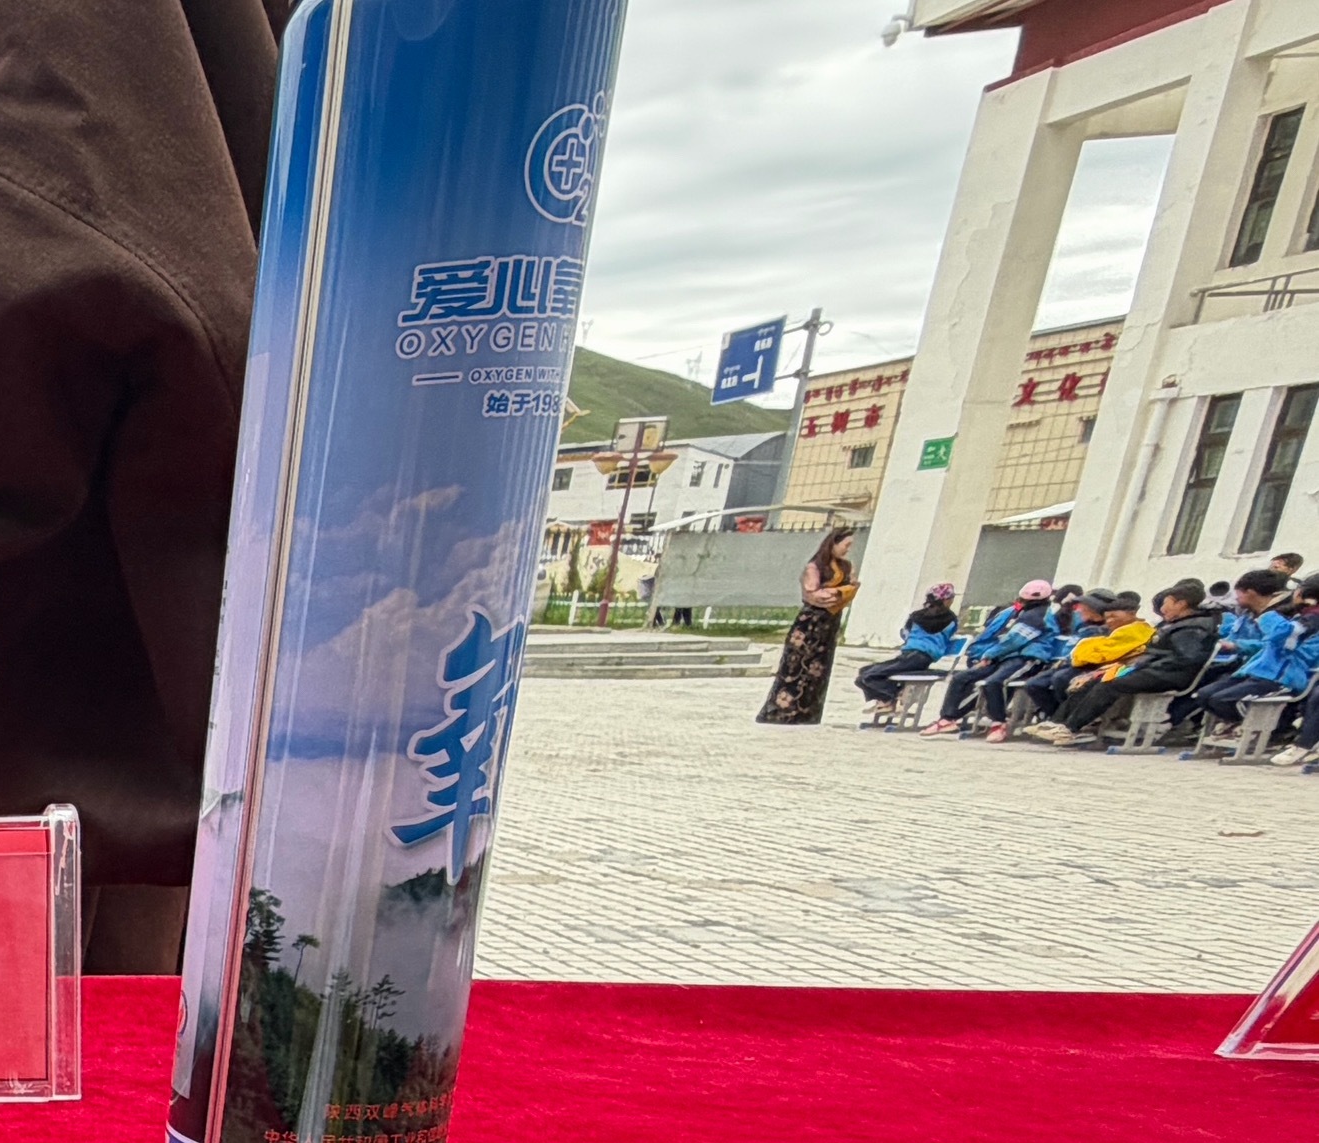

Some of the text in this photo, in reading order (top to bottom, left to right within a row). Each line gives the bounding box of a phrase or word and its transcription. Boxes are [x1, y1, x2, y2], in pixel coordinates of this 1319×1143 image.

[396, 322, 556, 359] OXYGEN
[468, 366, 534, 385] OXYGEN
[1011, 366, 1112, 407] 文化
